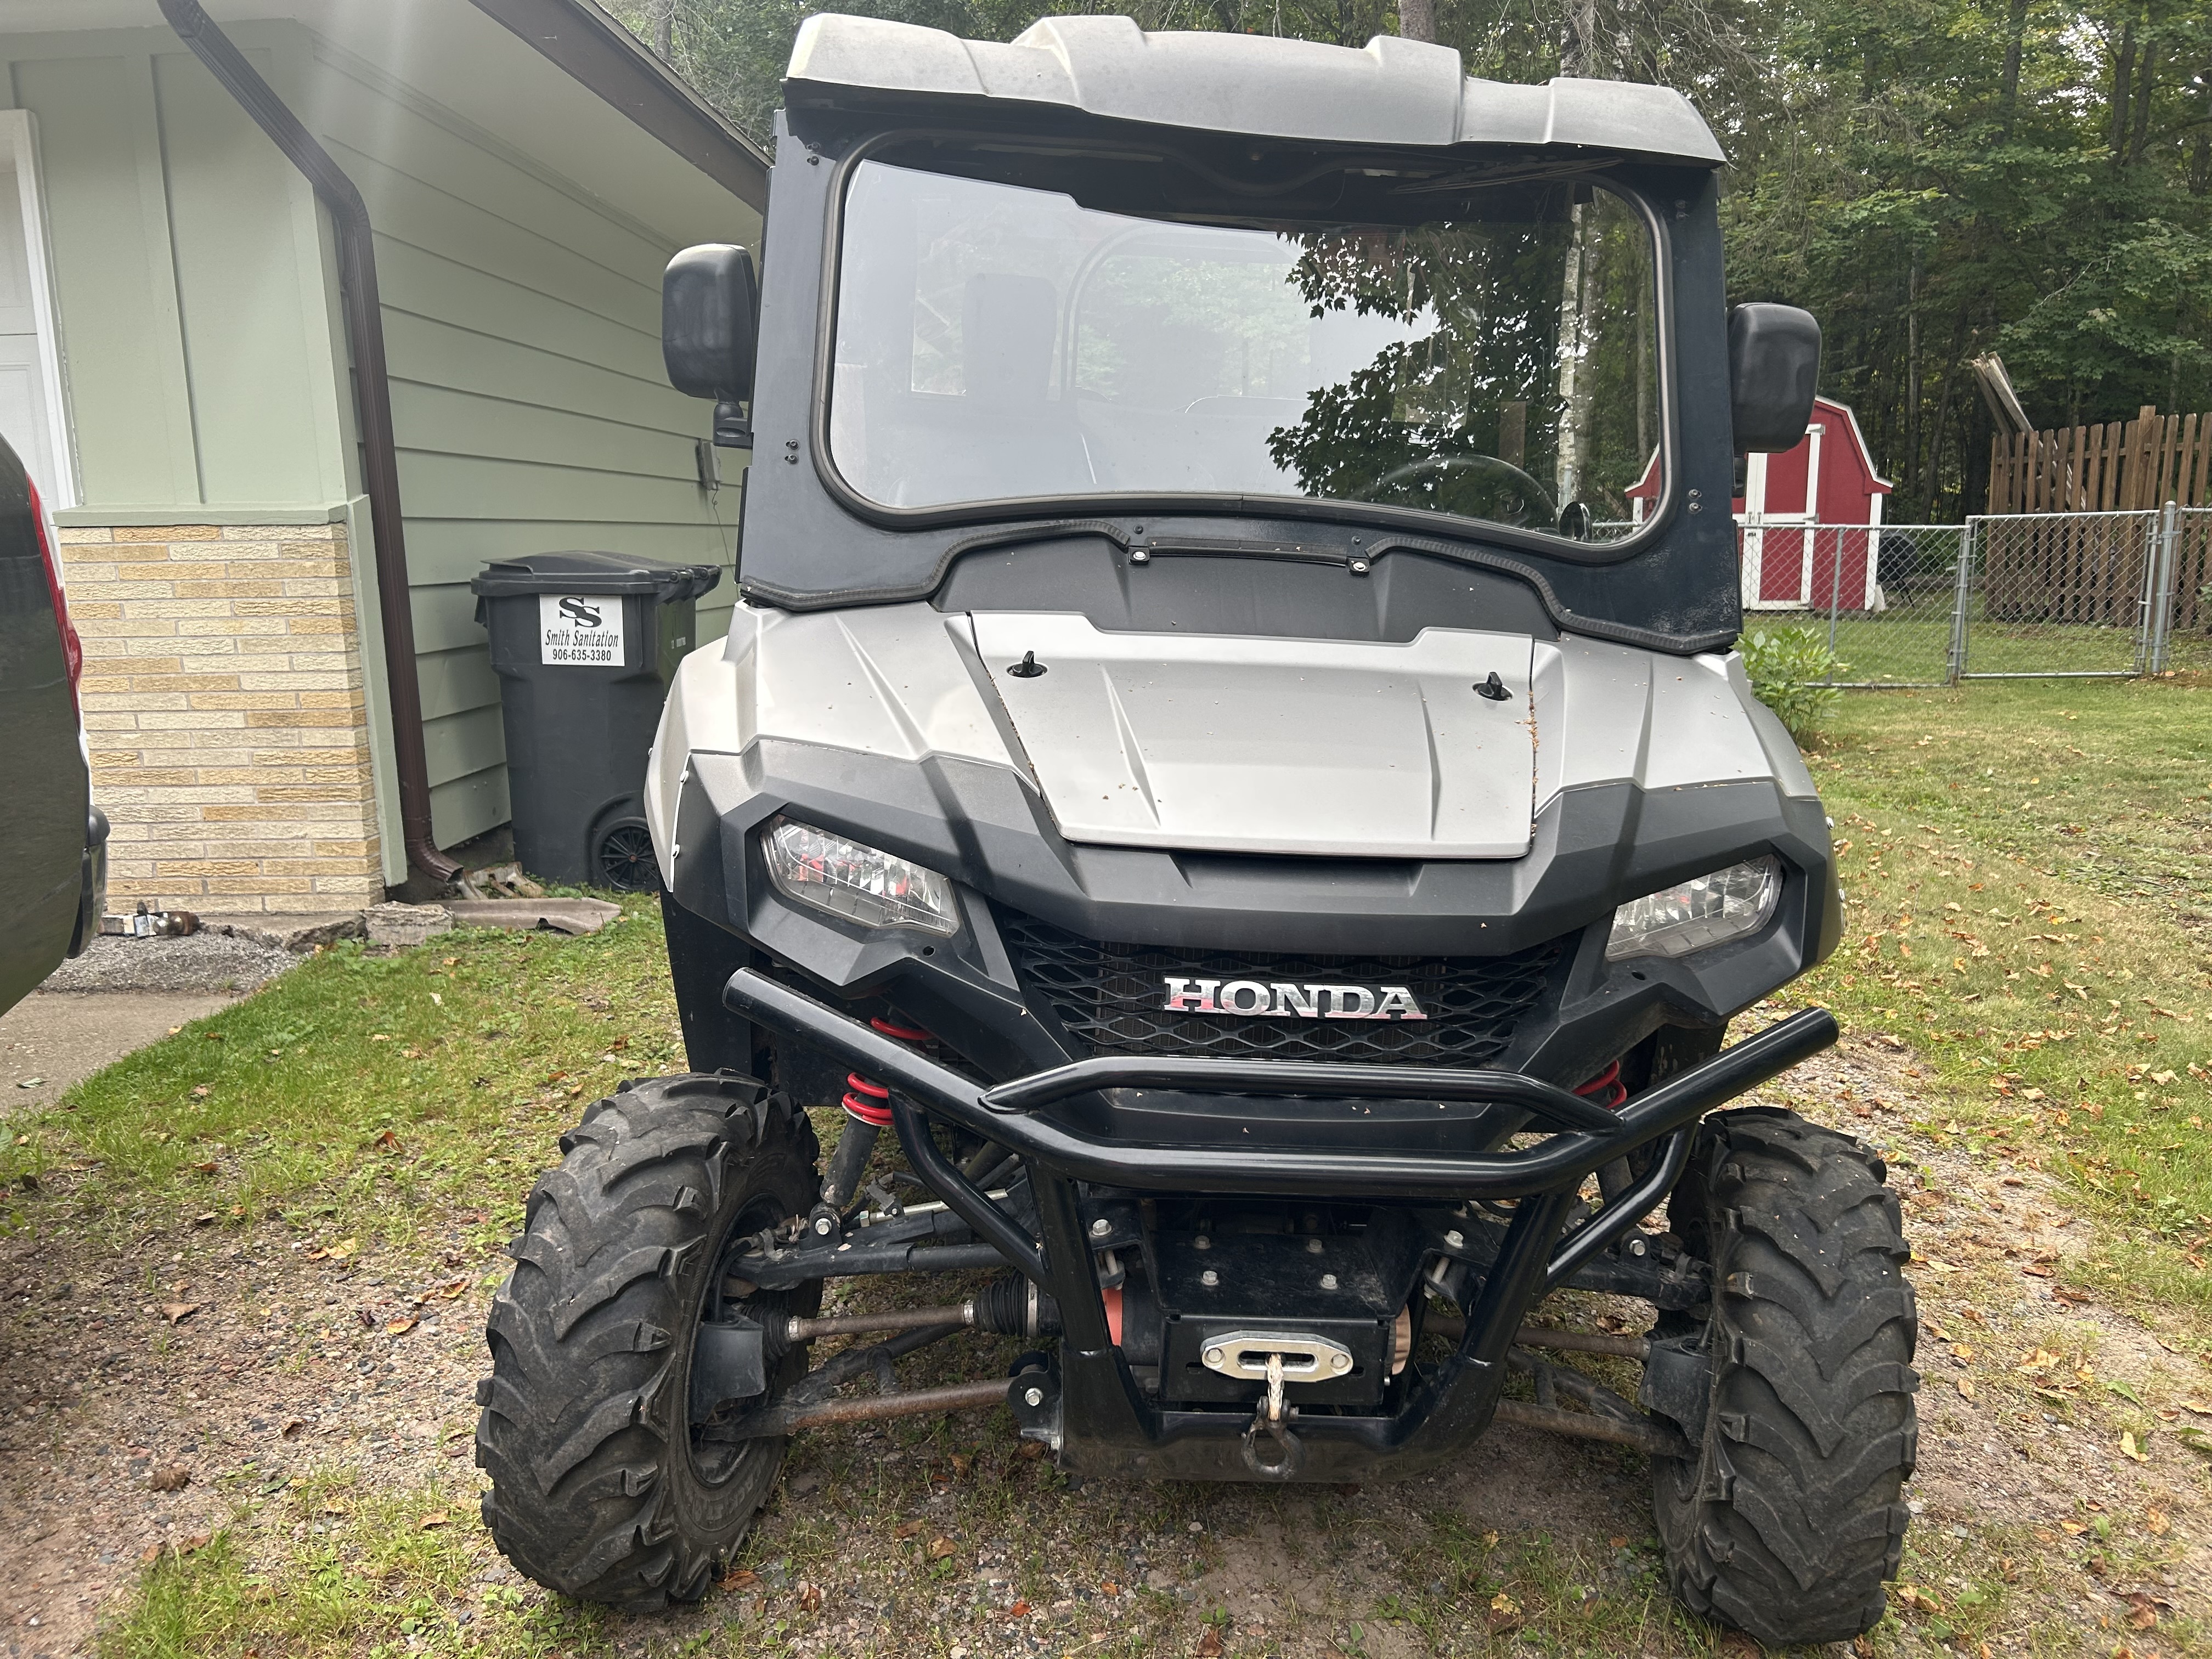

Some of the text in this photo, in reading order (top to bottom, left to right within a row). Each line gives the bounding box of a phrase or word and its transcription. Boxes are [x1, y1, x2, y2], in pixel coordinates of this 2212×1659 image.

[545, 629, 618, 647] Smith Sanitation
[552, 648, 611, 661] 906-635-3380
[1164, 977, 1428, 1020] HONDA
